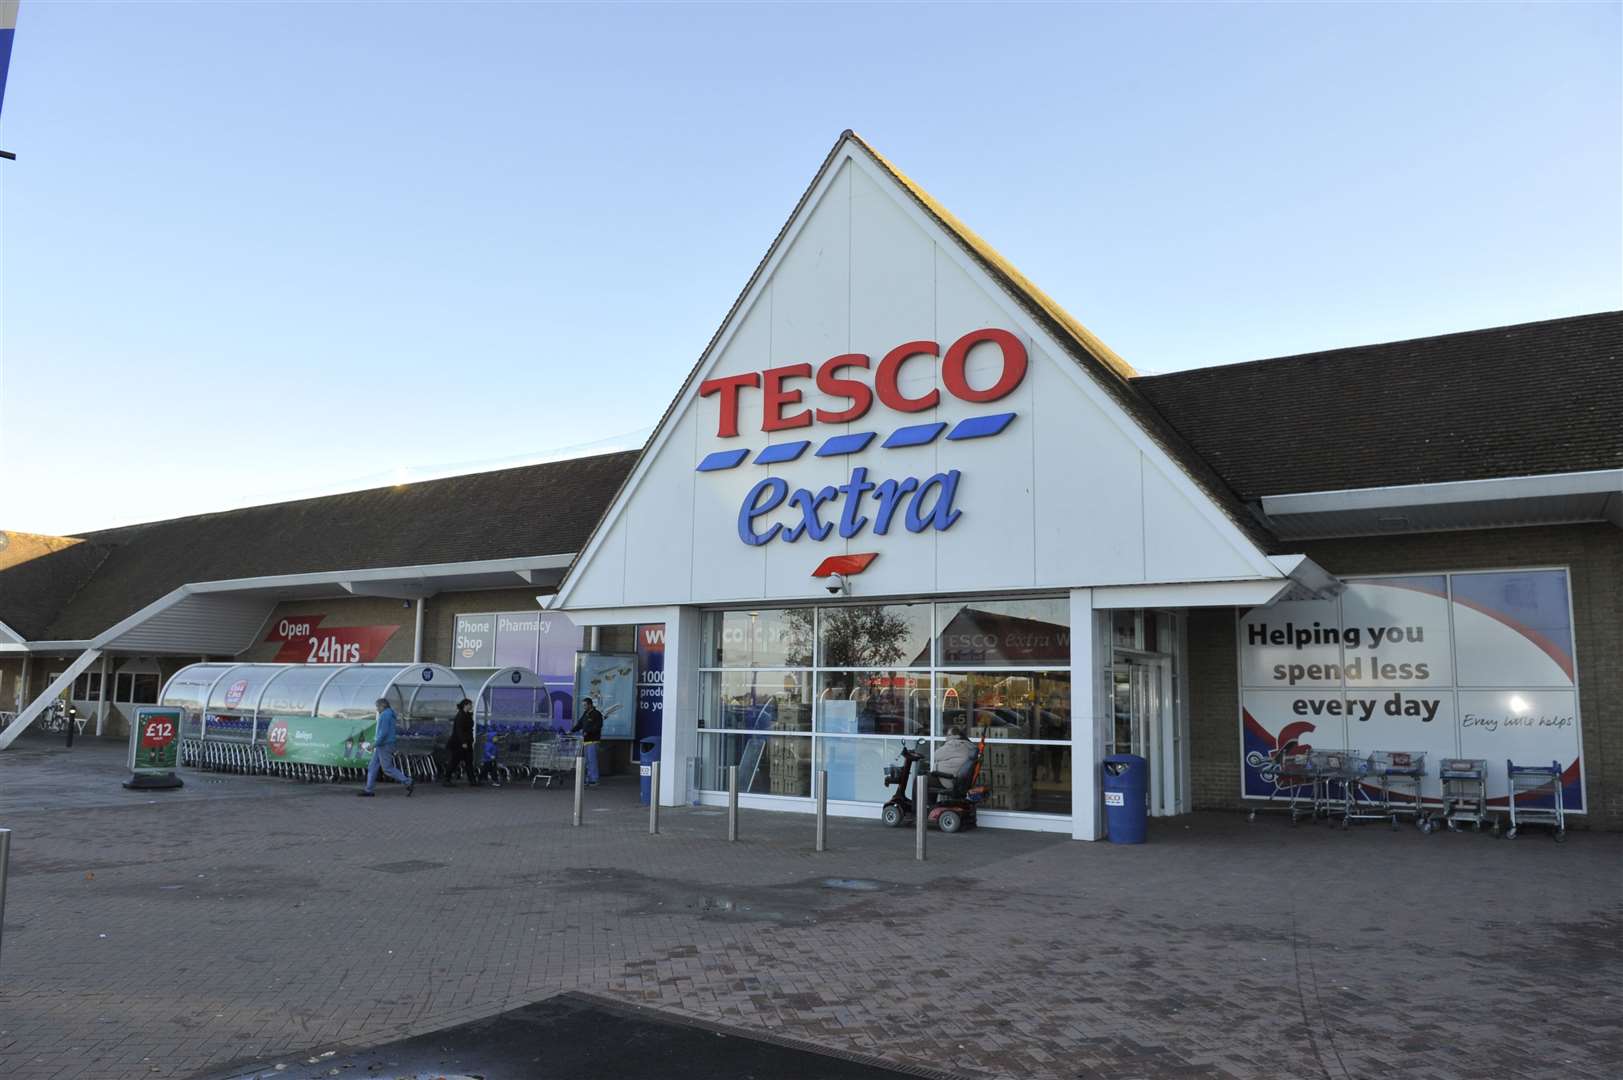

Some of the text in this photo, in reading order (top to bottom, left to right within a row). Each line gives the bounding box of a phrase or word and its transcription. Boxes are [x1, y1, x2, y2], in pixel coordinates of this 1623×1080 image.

[700, 328, 1029, 438] TESCO
[738, 467, 963, 547] extra
[279, 619, 310, 640] Open
[457, 619, 489, 633] Phone
[499, 619, 552, 634] Pharmacy
[1248, 622, 1424, 650] Helping you
[306, 636, 360, 663] 24hrs
[457, 636, 483, 653] Shop
[1273, 656, 1430, 686] spend less
[640, 701, 650, 710] to
[1292, 693, 1441, 723] every day
[146, 723, 172, 737] £12
[1462, 713, 1498, 732] Every
[1538, 715, 1574, 729] helps
[270, 727, 288, 743] £12
